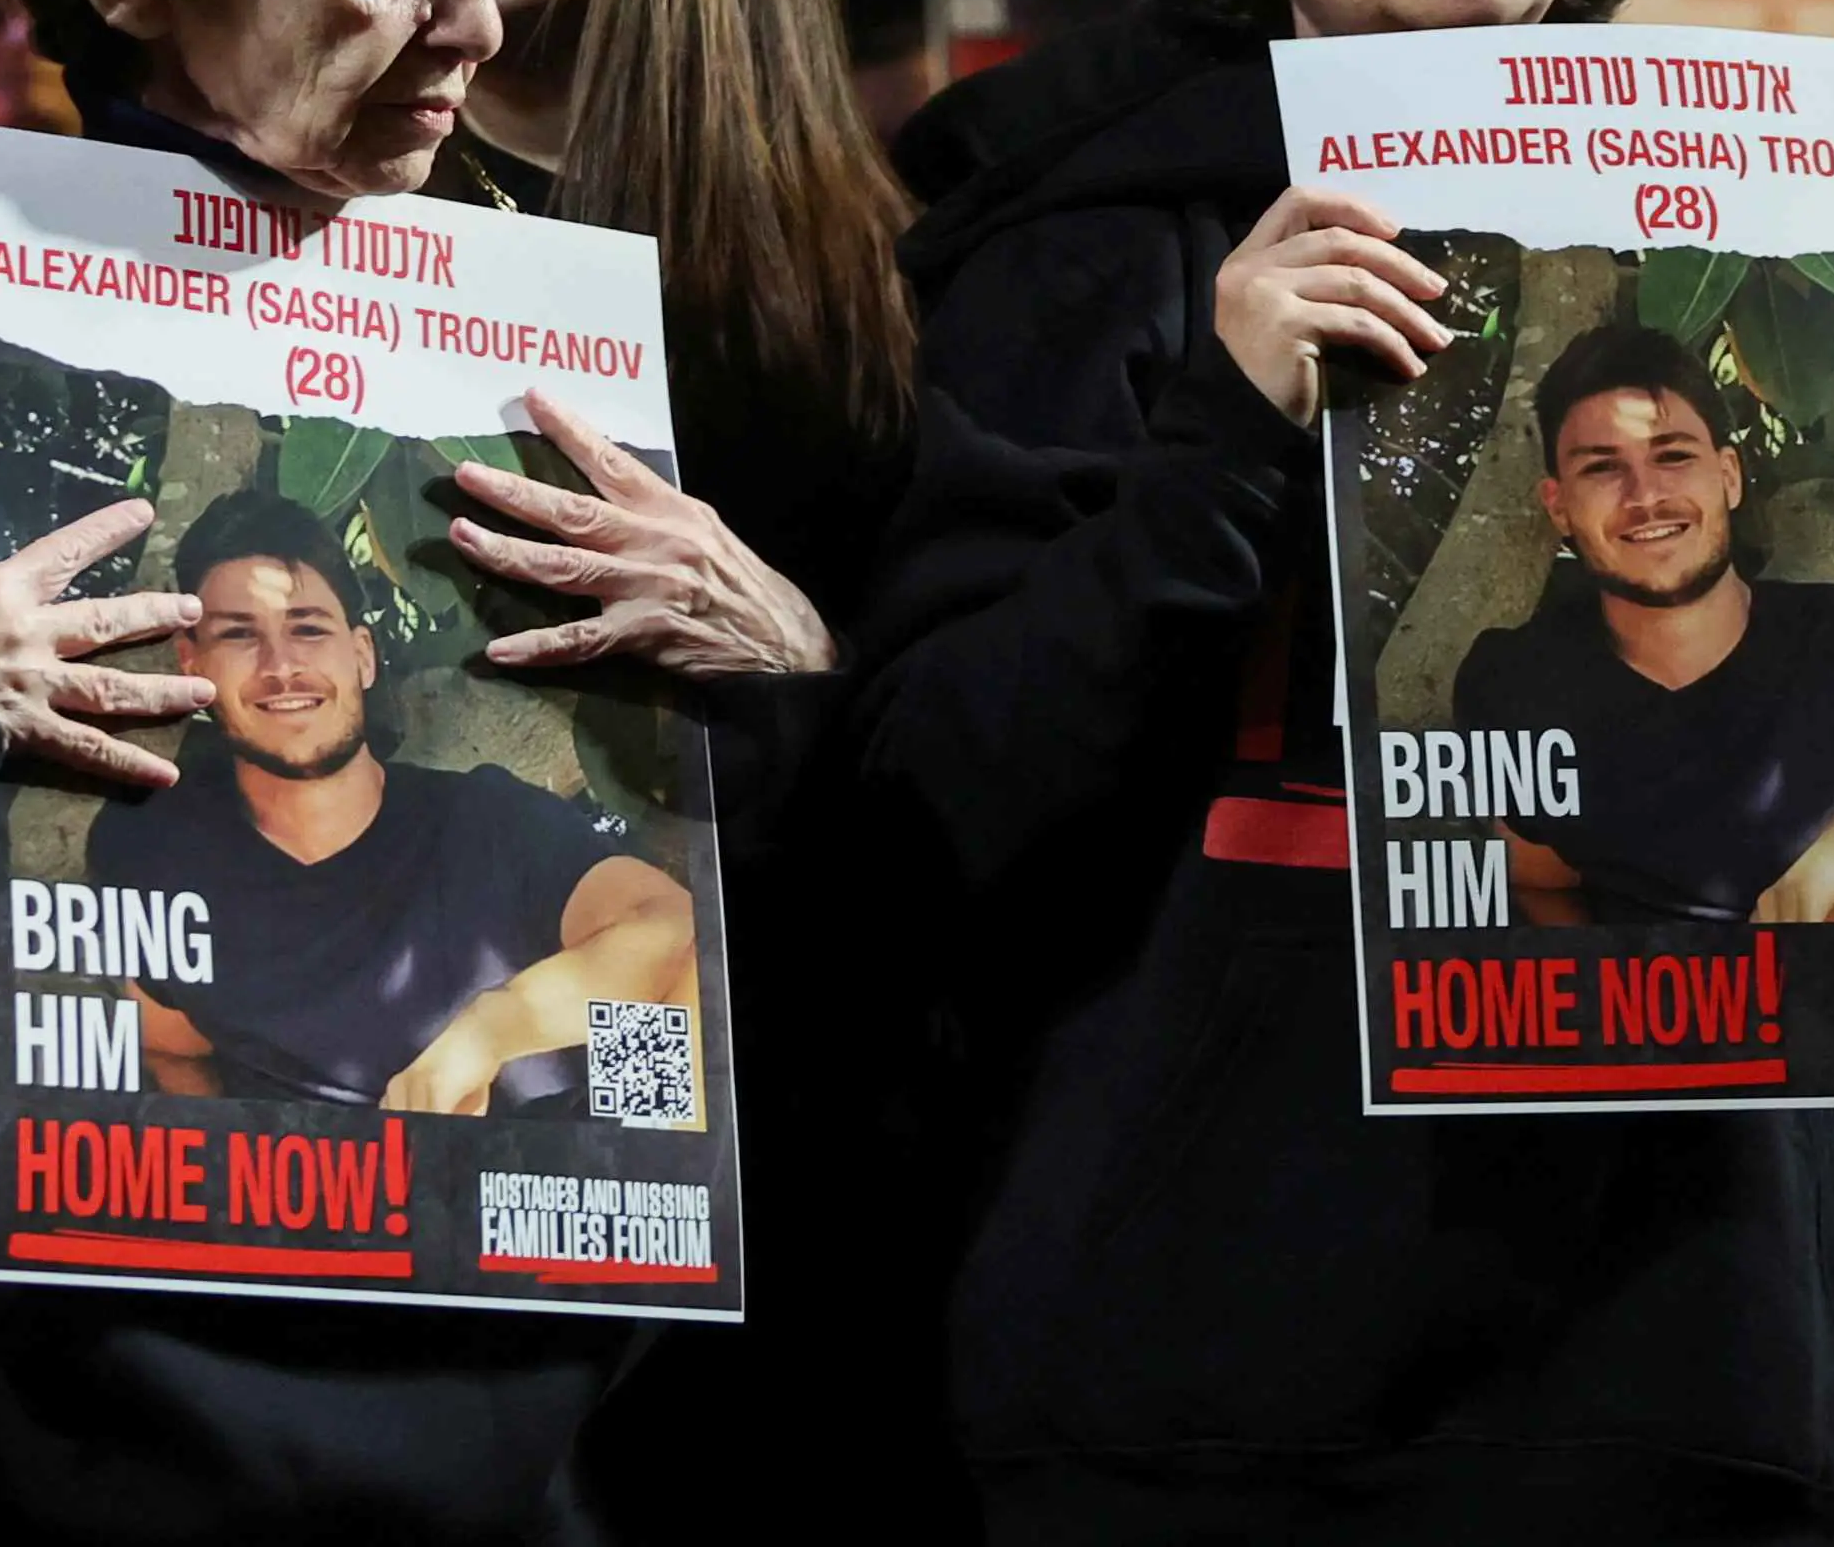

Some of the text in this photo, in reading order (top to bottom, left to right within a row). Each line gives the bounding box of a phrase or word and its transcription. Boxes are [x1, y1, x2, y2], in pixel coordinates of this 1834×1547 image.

[1499, 55, 1797, 115] אלכסנדר טרופנוב
[1317, 127, 1569, 174] ALEXANDER
[1587, 129, 1747, 181] (SASHA)
[173, 188, 455, 288] אלכסנדר טרופנוב
[1634, 184, 1718, 241] (28)
[247, 281, 400, 352] (SASHA)
[414, 309, 643, 381] TROUFANOV
[285, 346, 365, 414] (28)
[1379, 729, 1580, 818] BRING
[1386, 839, 1510, 929] HIM
[10, 879, 213, 984] BRING
[1392, 931, 1784, 1049] HOME NOW!
[14, 992, 140, 1092] HIM
[16, 1117, 410, 1235] HOME NOW!
[481, 1171, 709, 1218] HOSTAGES AND MISSING
[481, 1208, 712, 1268] FAMILIES FORUM
